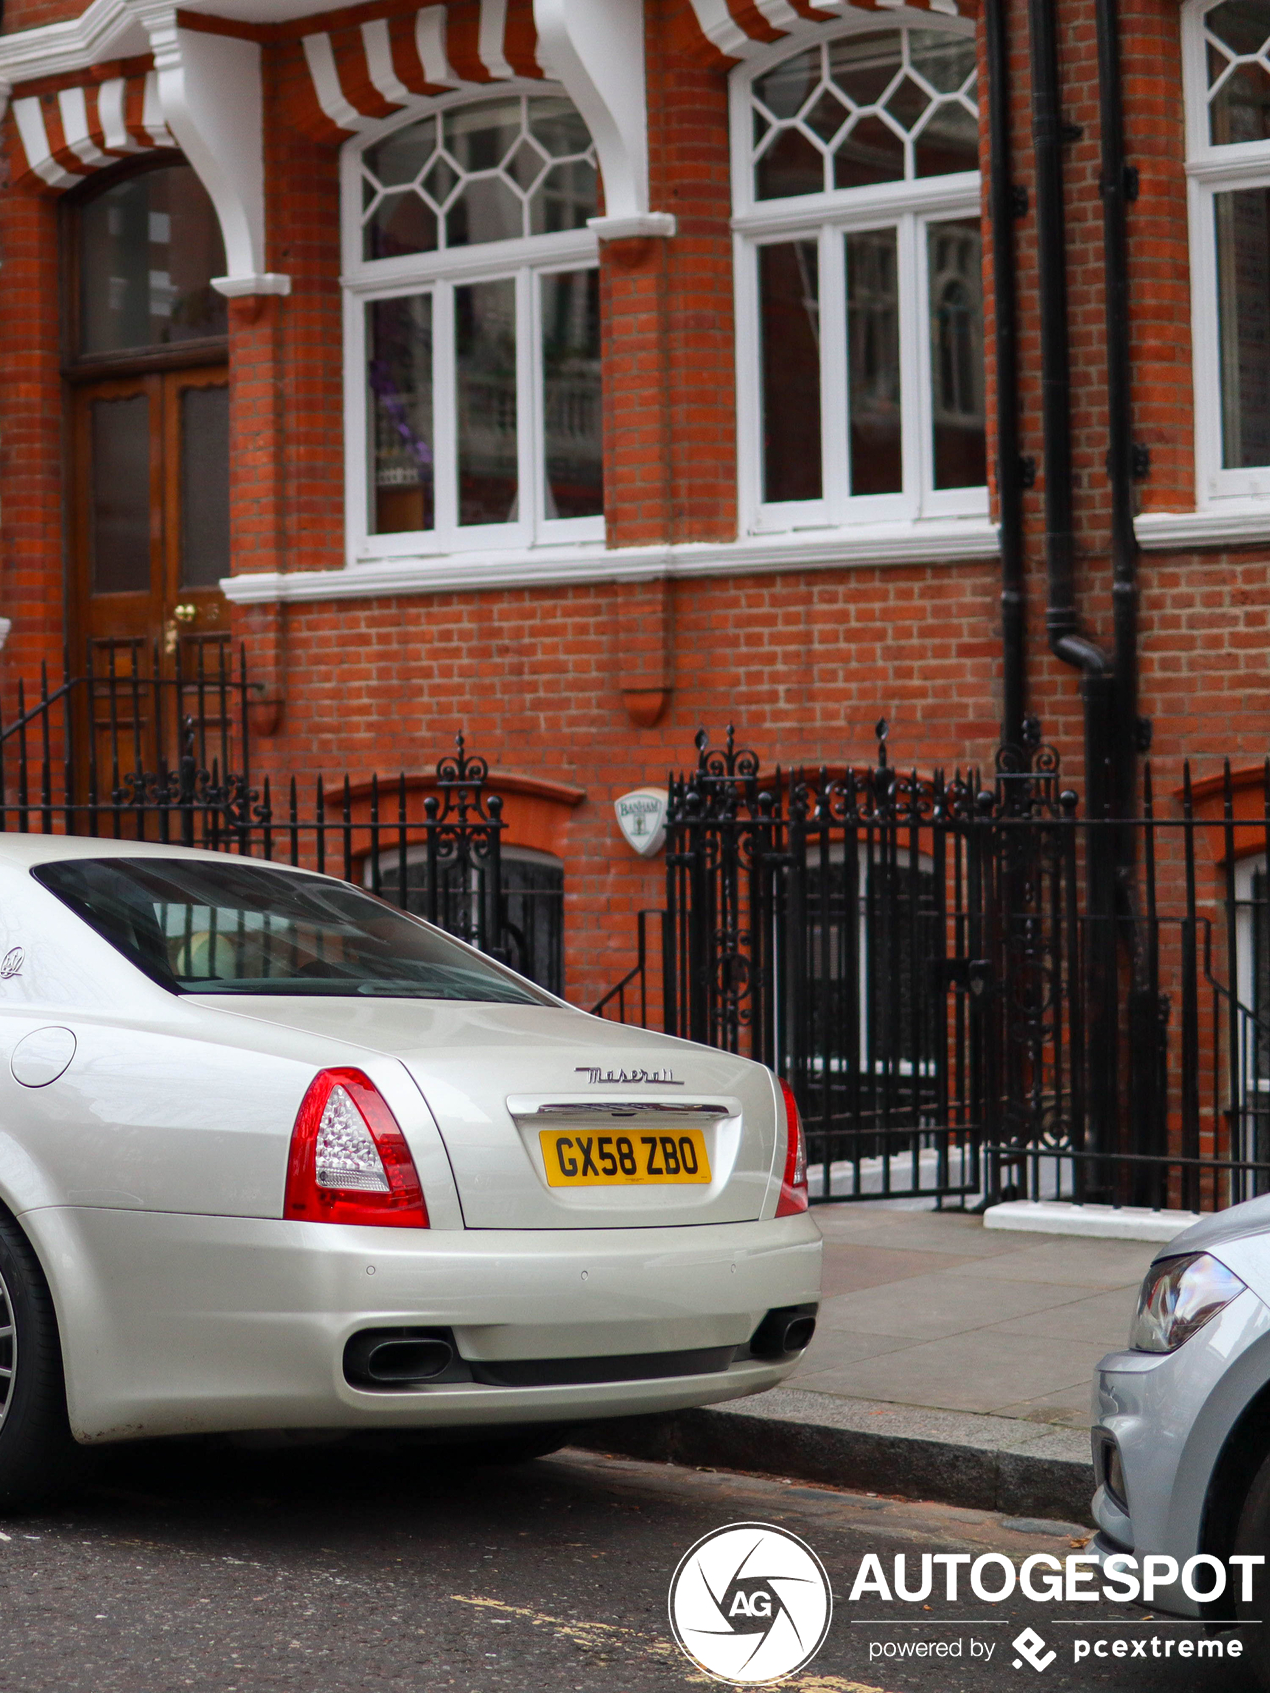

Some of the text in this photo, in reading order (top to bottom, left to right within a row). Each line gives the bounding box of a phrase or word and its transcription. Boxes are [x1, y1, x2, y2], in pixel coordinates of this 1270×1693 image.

[620, 800, 659, 816] BANHAM
[574, 1066, 685, 1086] Maserati
[555, 1136, 637, 1177] GX58
